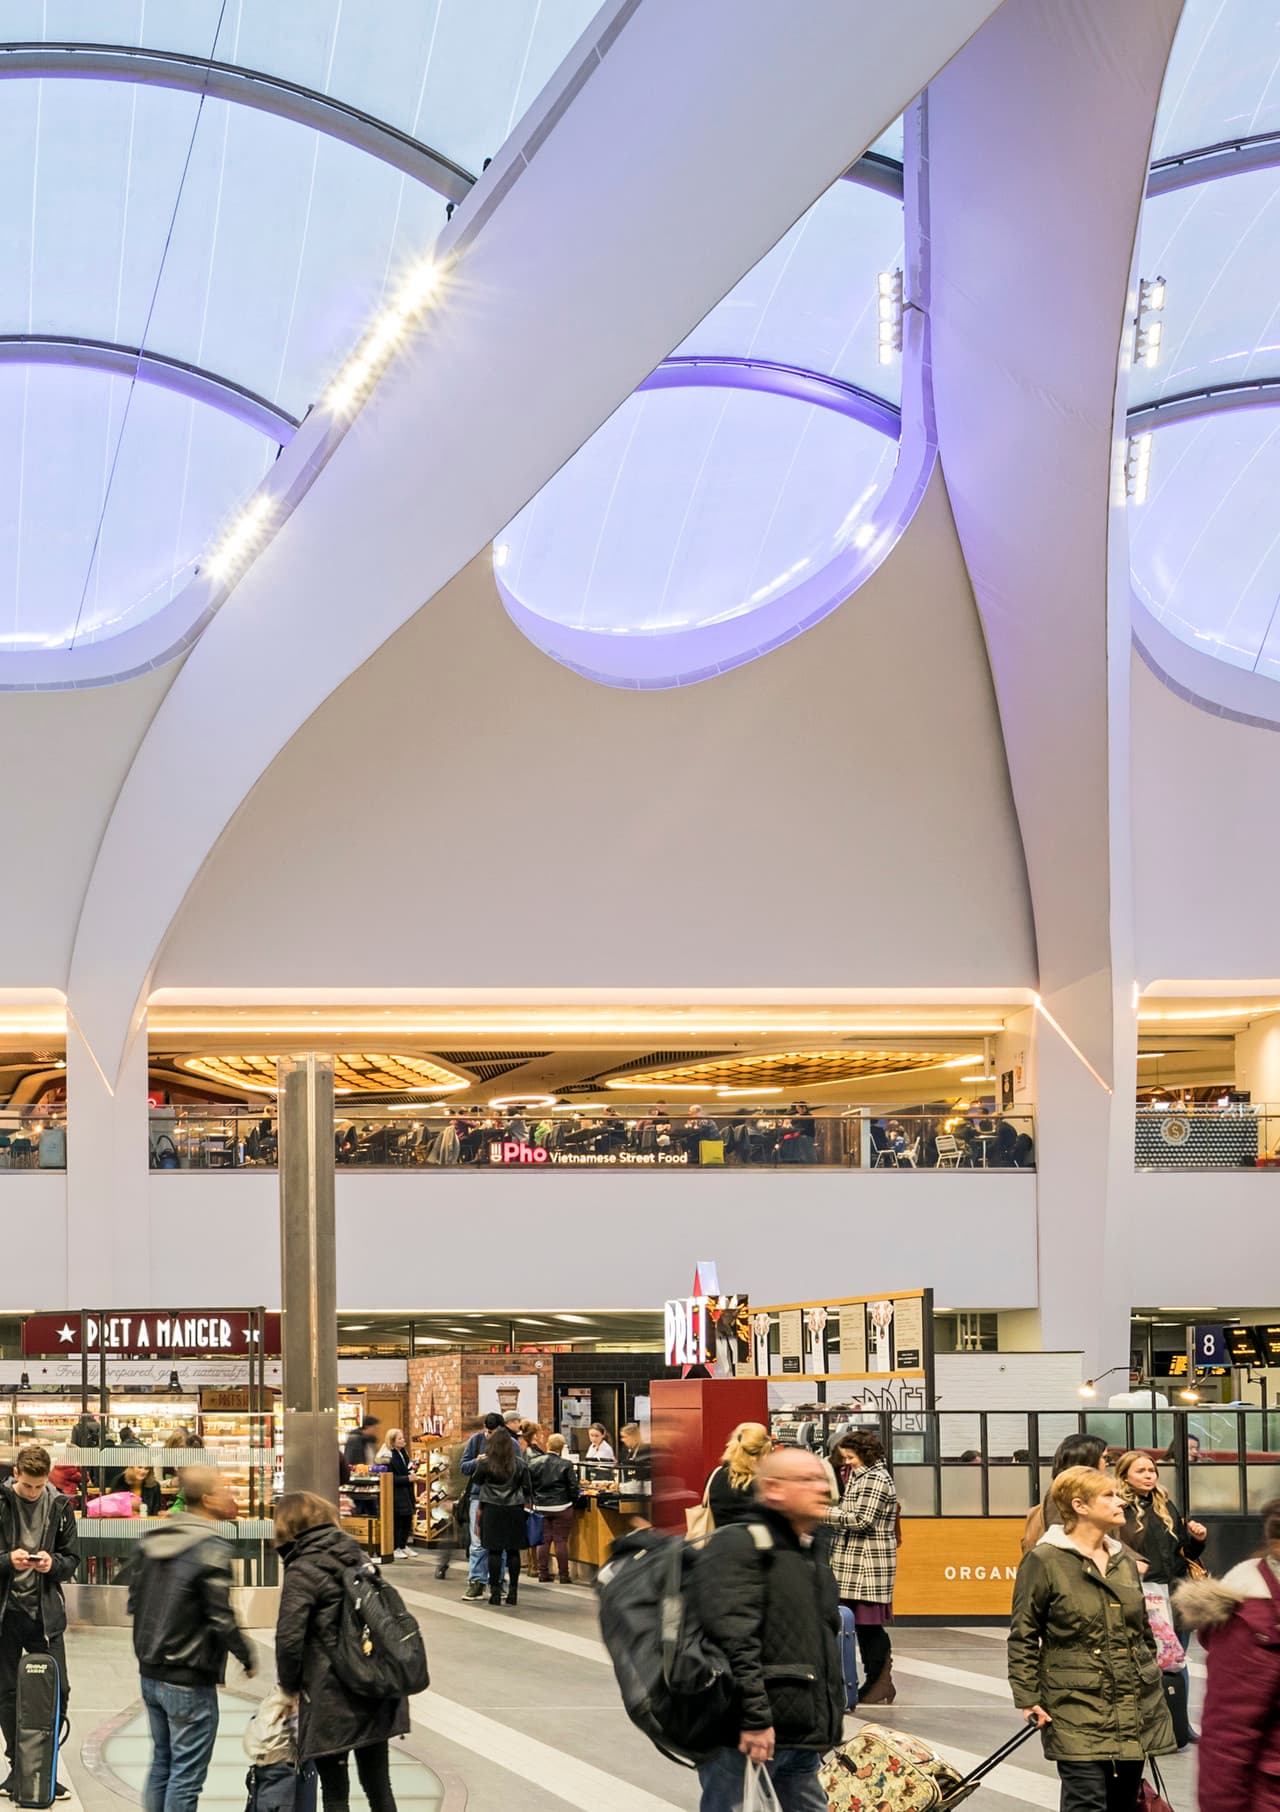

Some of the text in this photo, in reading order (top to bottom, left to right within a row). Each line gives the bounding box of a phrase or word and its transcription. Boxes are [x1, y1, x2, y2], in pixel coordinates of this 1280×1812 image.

[504, 1143, 688, 1163] Pho Vietnamese Street Food
[87, 1318, 232, 1347] PRET A MANGER
[664, 1296, 709, 1367] PRET
[1203, 1334, 1215, 1356] 8
[944, 1566, 1018, 1580] ORGAN
